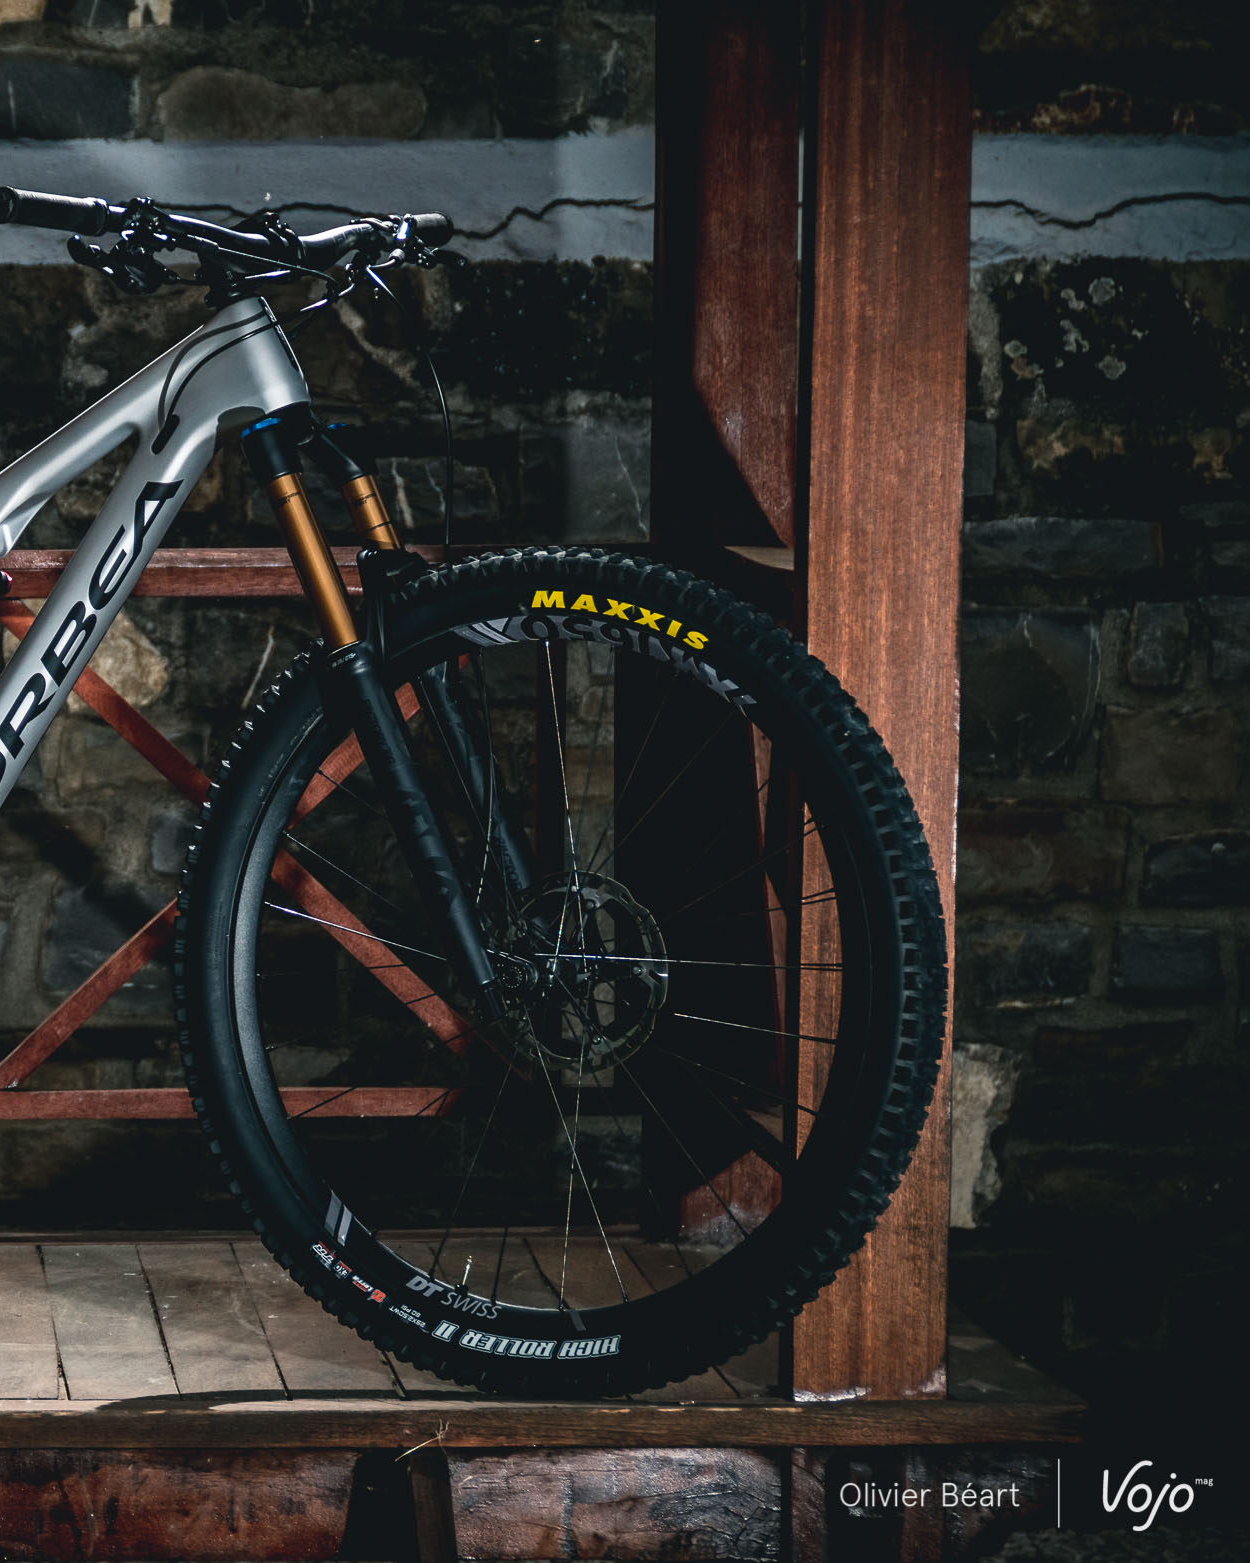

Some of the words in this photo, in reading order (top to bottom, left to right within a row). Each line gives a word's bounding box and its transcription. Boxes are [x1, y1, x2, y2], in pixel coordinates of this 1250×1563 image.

[531, 590, 710, 650] MAXXIS
[406, 1275, 444, 1298] DT
[441, 1292, 502, 1320] SWISS
[431, 1319, 460, 1343] II
[459, 1328, 557, 1360] ROLLER
[557, 1334, 622, 1360] HIGH
